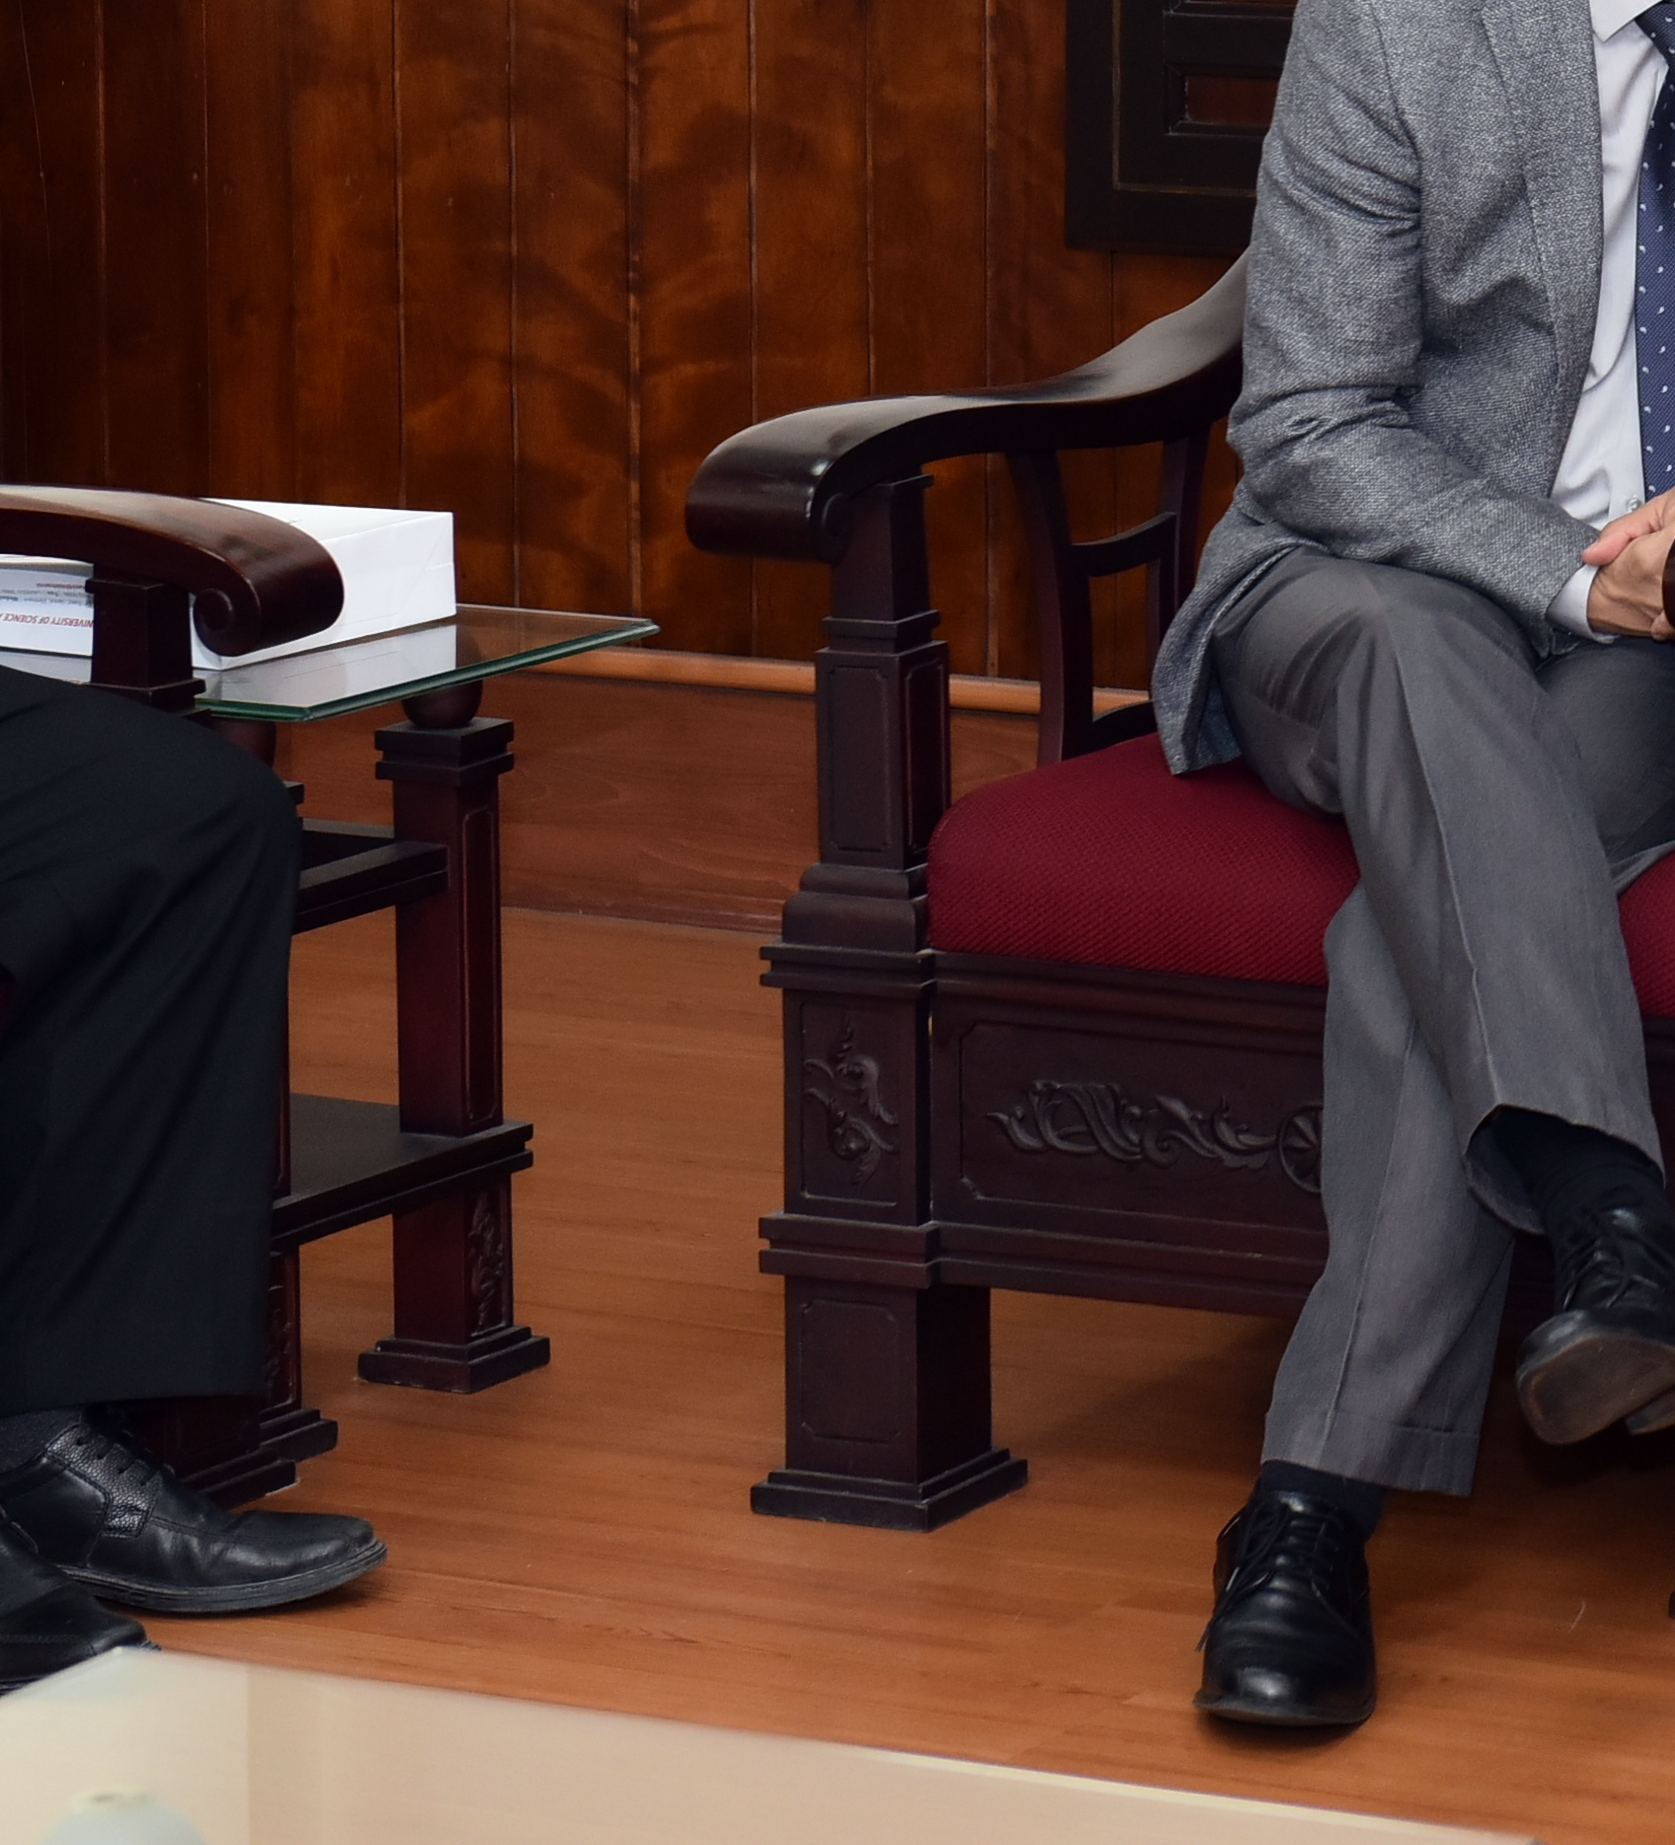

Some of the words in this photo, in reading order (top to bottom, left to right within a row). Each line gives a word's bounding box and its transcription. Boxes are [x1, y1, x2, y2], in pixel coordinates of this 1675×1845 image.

[3, 613, 38, 624] SCIENCE
[39, 616, 50, 624] OF
[51, 617, 94, 628] NIVERSITY
